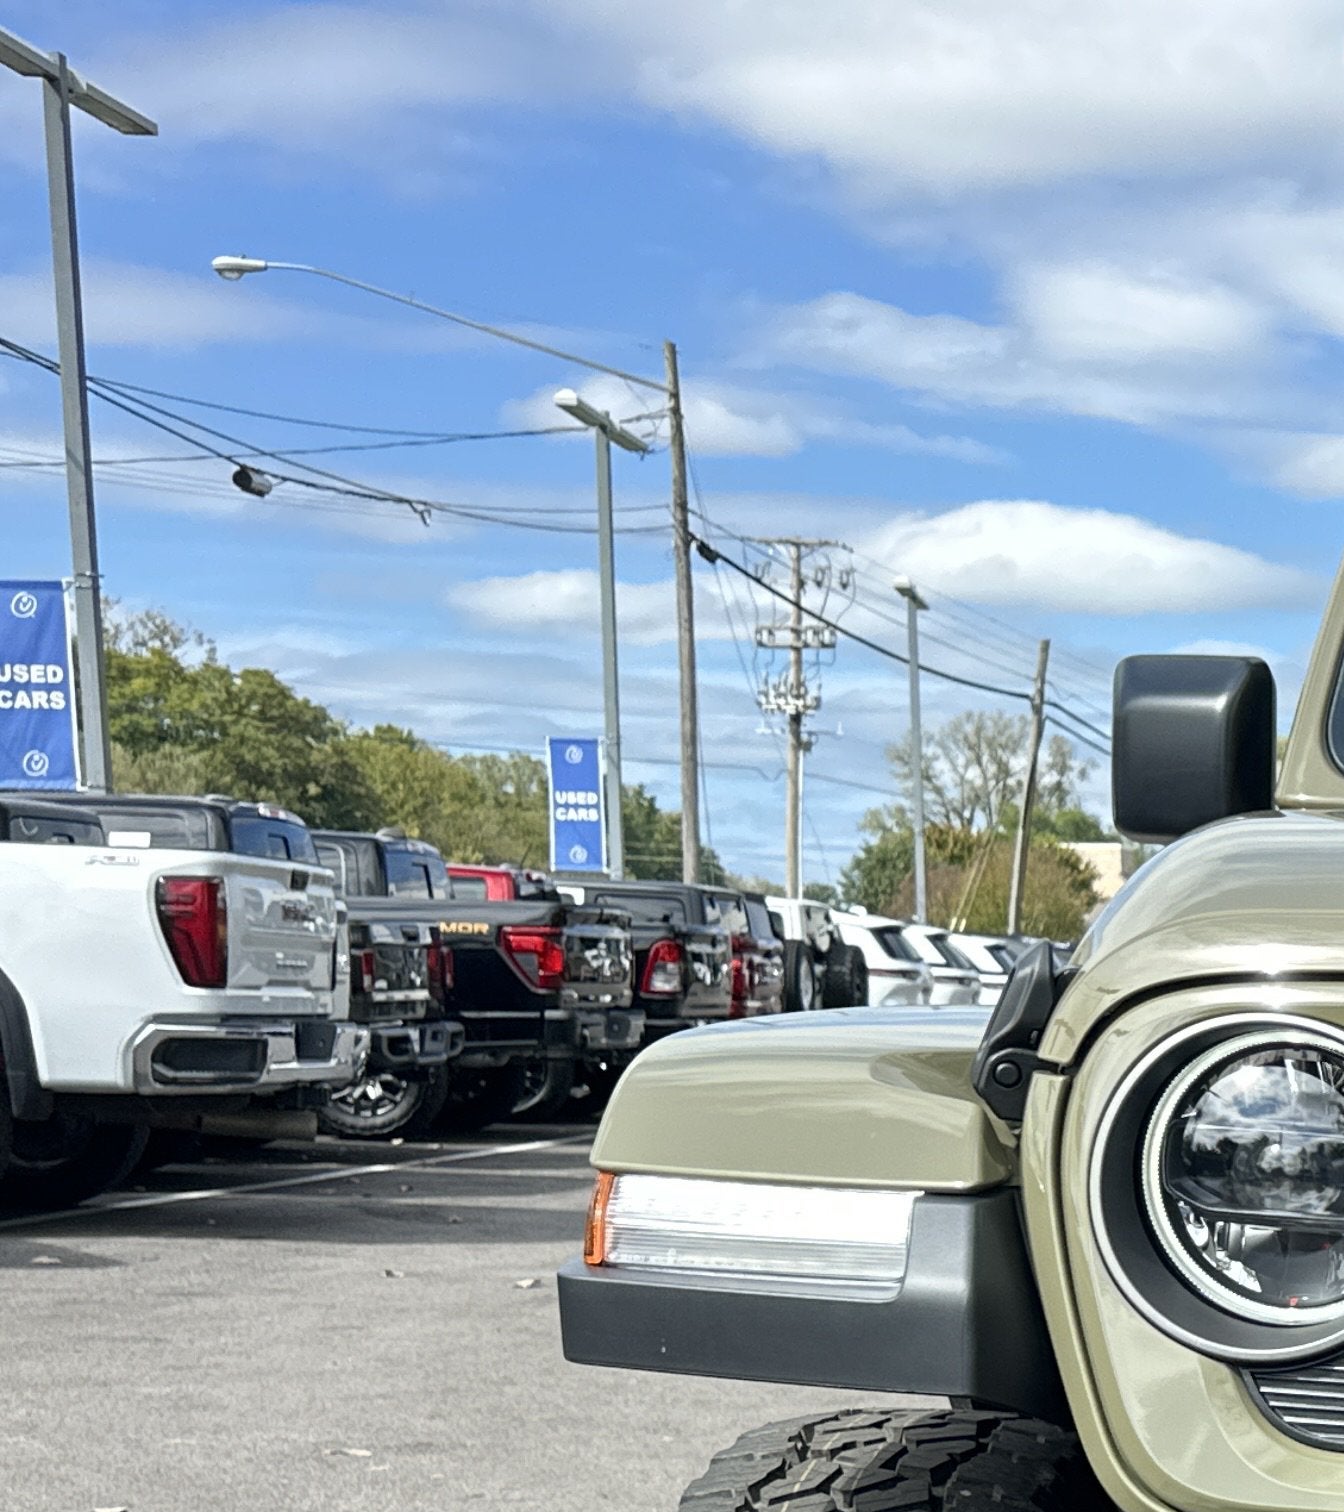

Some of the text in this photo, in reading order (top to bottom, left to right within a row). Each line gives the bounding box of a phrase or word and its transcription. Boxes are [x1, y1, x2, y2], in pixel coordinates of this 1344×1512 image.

[0, 663, 64, 684] USED
[0, 690, 66, 710] CARS
[555, 790, 598, 805] USED
[555, 807, 599, 822] CARS
